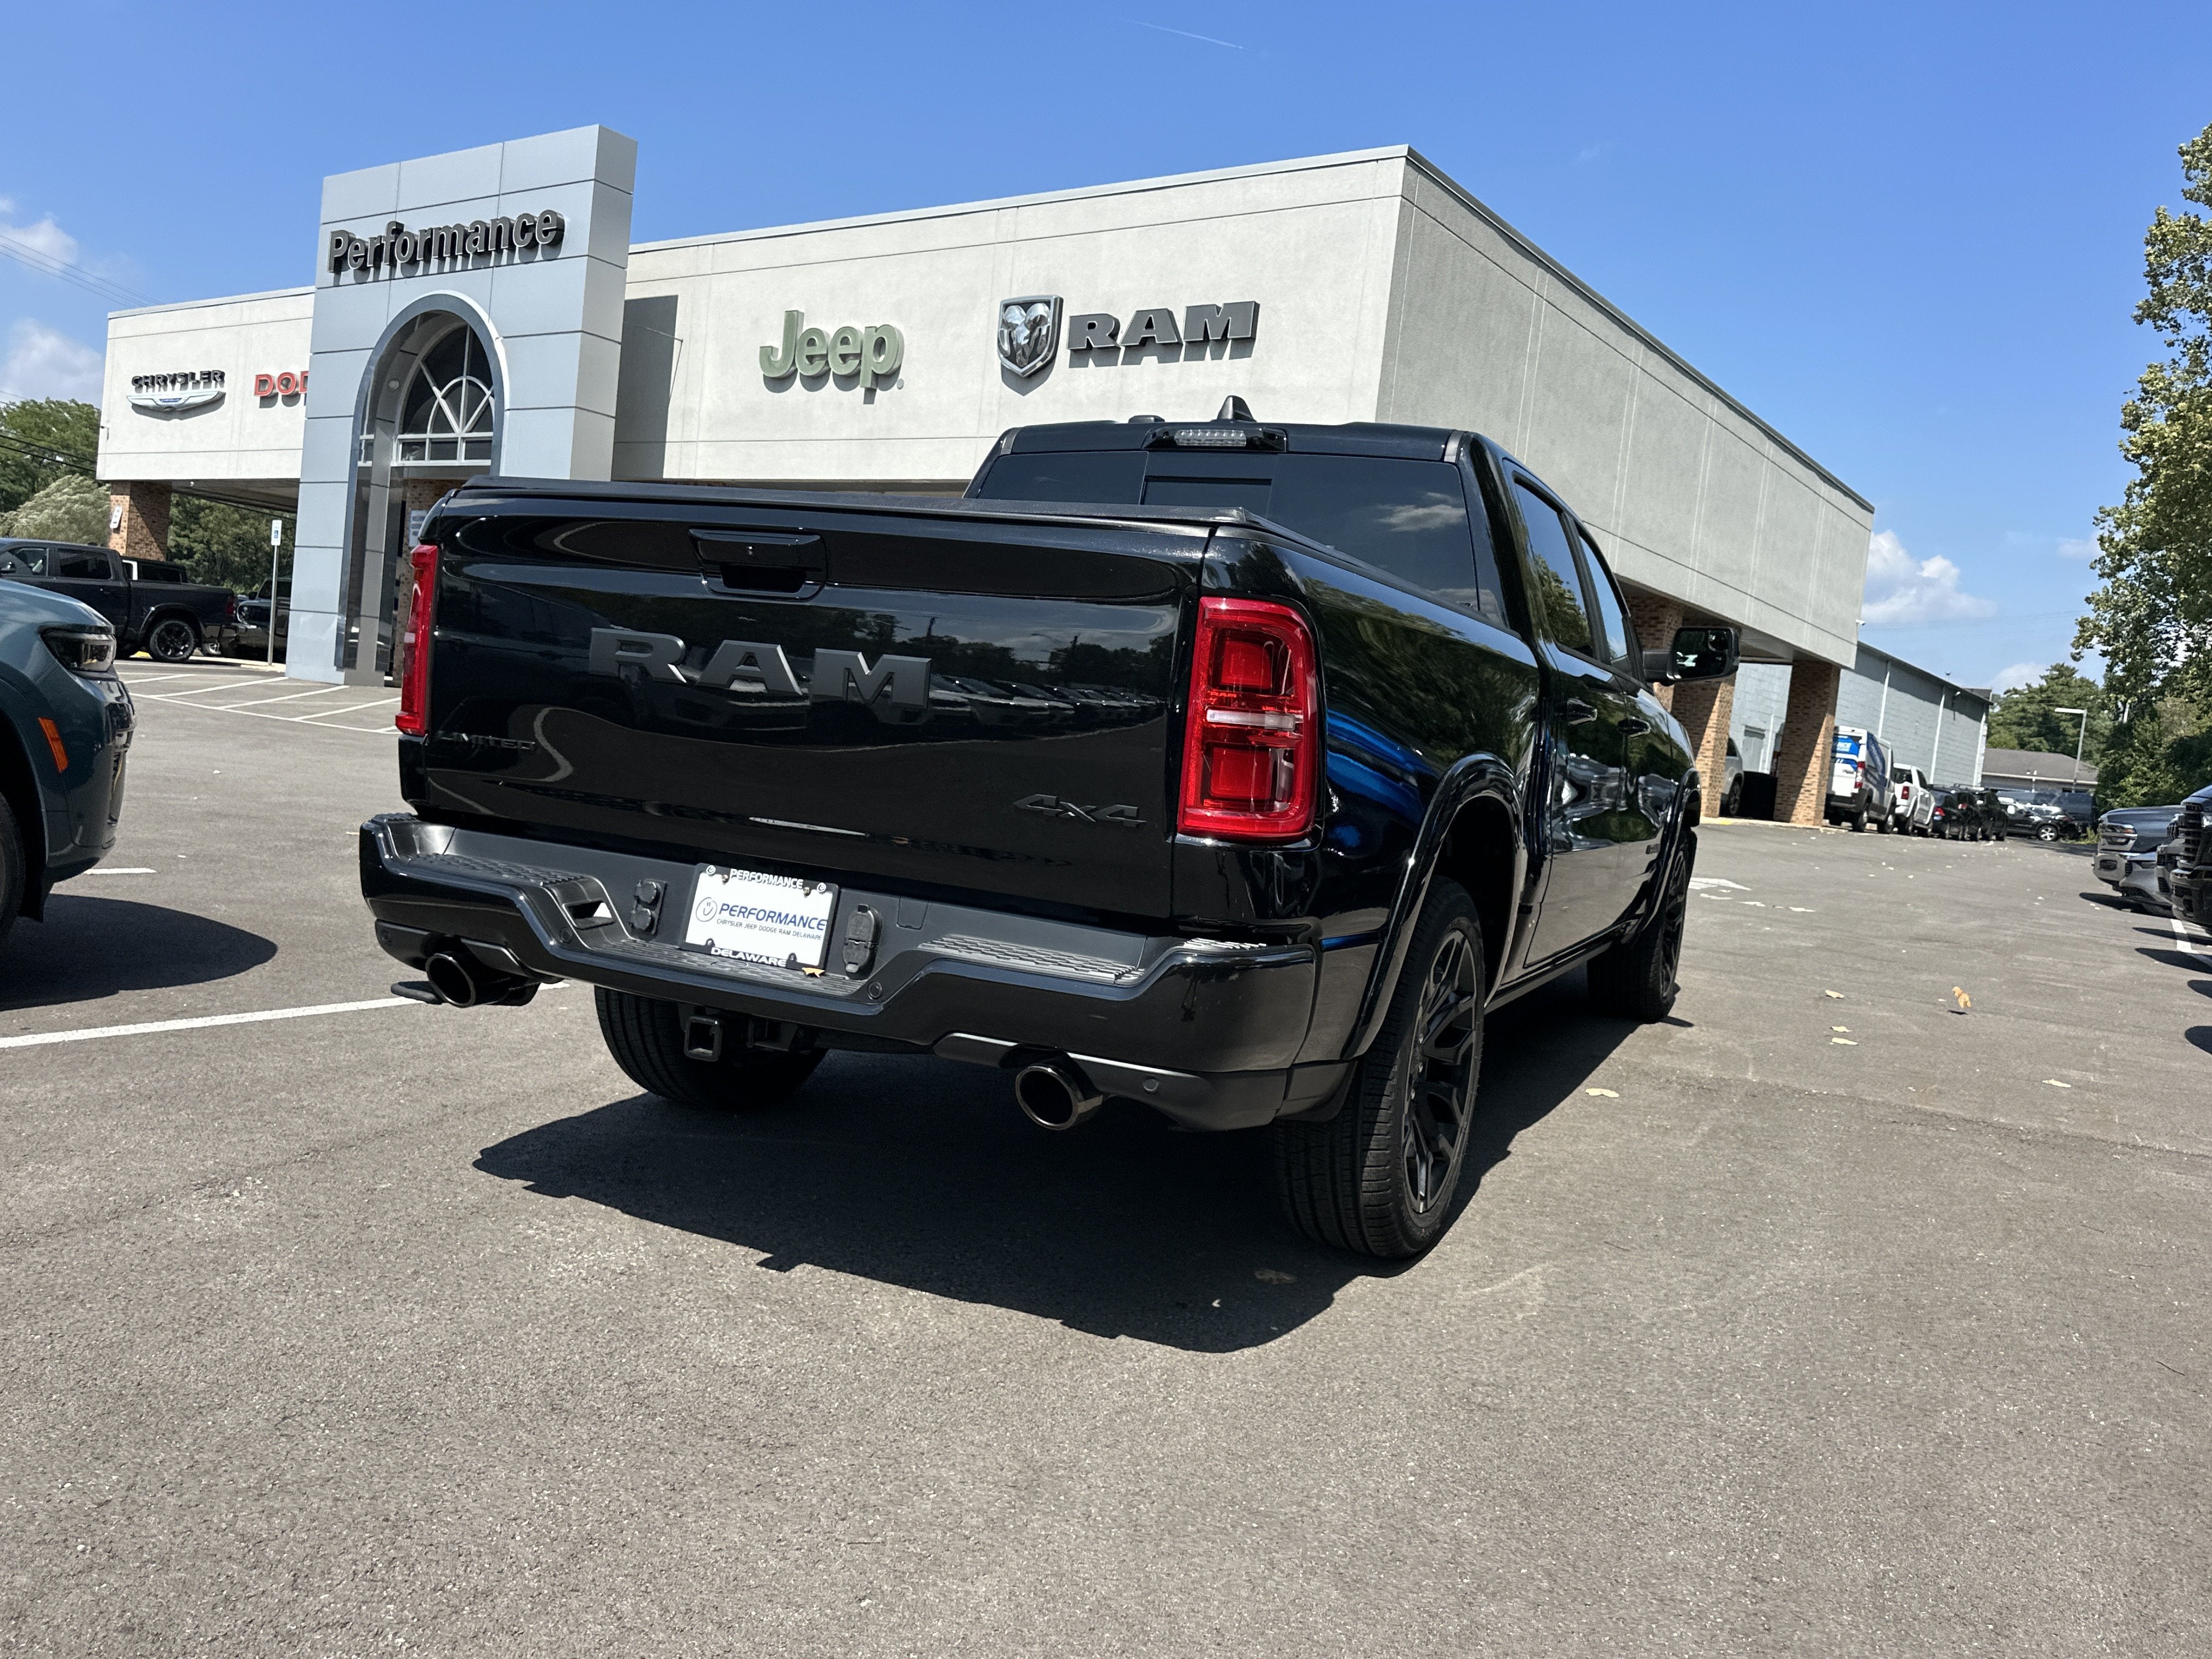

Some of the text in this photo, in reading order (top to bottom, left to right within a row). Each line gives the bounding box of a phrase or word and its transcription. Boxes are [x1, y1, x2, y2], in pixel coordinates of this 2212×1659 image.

[329, 210, 564, 272] Performance
[1067, 301, 1260, 350] RAM
[759, 309, 904, 389] Jeep
[132, 369, 224, 387] CHRYSLER
[589, 627, 931, 710] RAM
[730, 868, 804, 889] PERFORMANCE
[716, 918, 743, 928] CHRYSLER
[792, 930, 821, 940] DELAWARE
[719, 903, 827, 930] PERFORMANCE
[710, 947, 787, 967] DELAWARE
